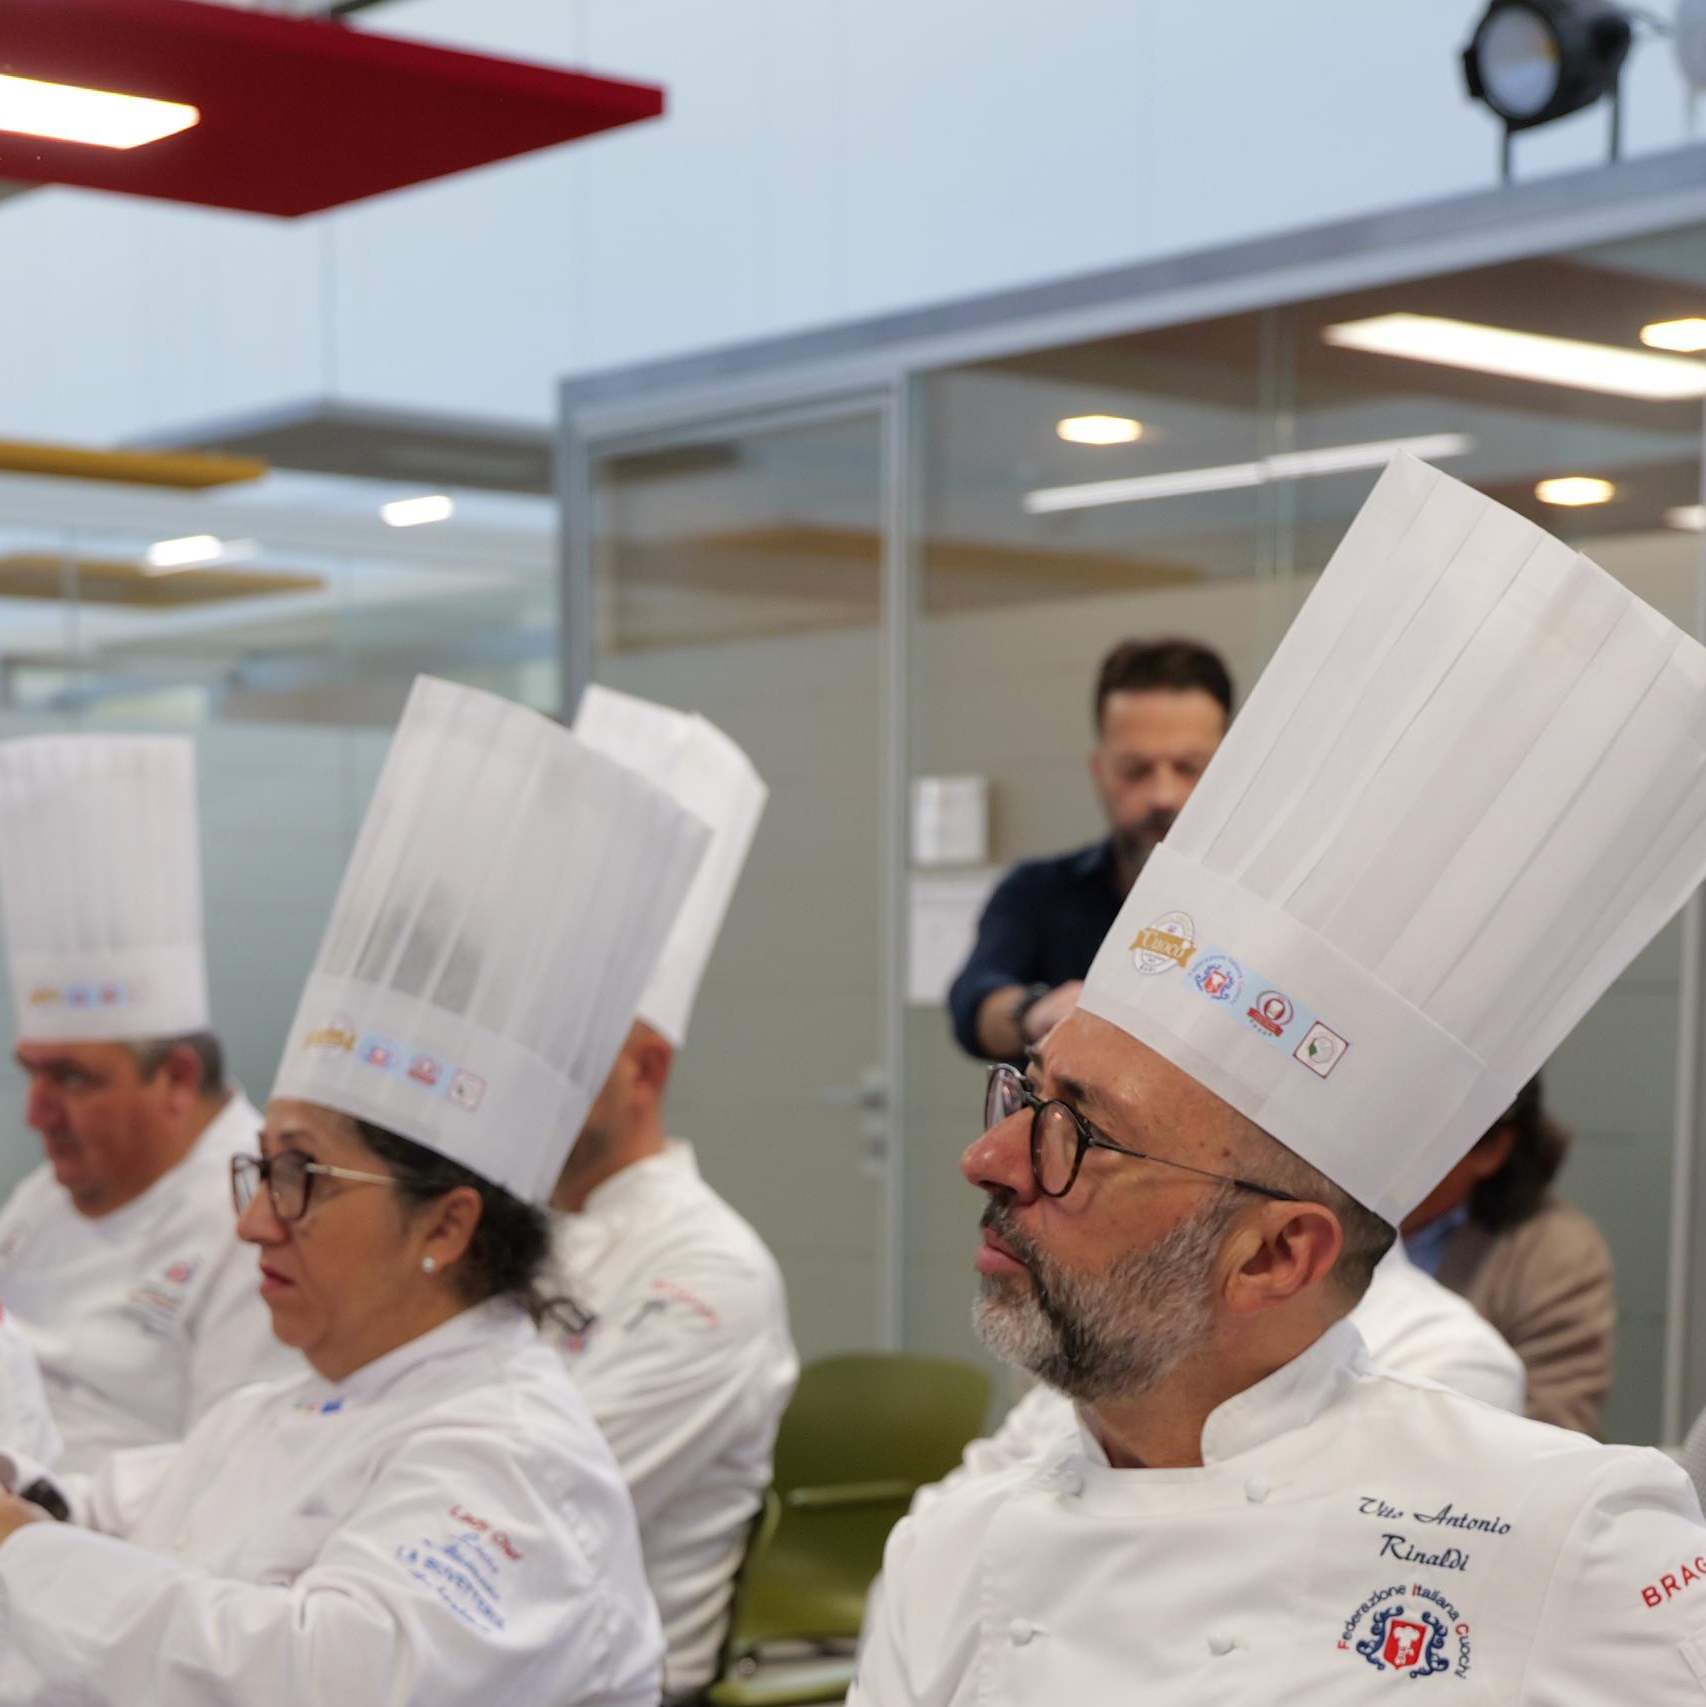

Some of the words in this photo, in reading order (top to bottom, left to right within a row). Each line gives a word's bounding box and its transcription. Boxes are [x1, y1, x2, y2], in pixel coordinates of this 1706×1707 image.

[1413, 1503, 1511, 1535] Antonio
[1379, 1533, 1470, 1572] Rinaldi
[1337, 1584, 1407, 1650] Federazione
[1411, 1582, 1461, 1623] Italiana
[1453, 1622, 1472, 1680] Cuochi
